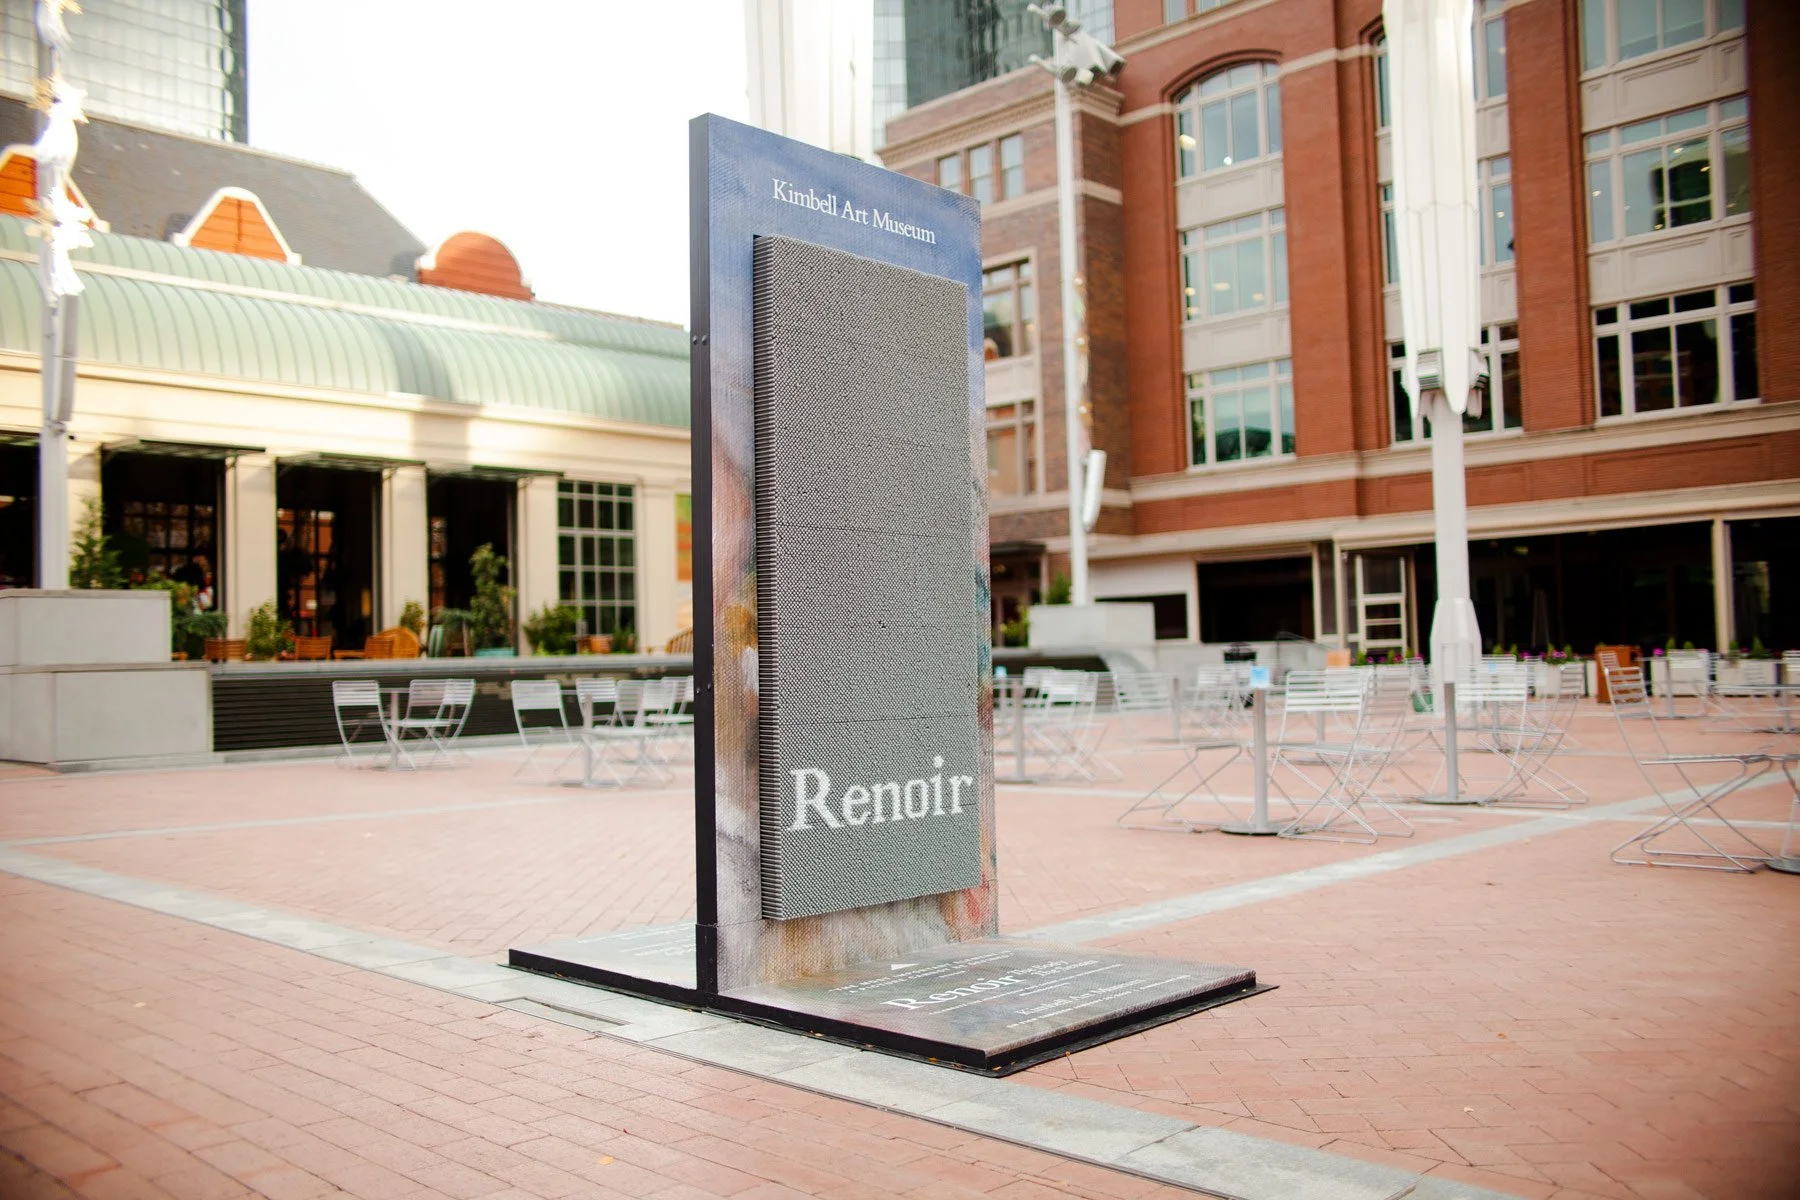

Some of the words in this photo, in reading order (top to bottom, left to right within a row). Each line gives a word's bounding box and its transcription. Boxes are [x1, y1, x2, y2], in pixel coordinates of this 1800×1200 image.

[772, 178, 837, 216] Kimbell
[841, 200, 868, 225] Art
[873, 208, 937, 244] Museum
[787, 755, 974, 832] Renoir
[879, 974, 1026, 1010] Renoir
